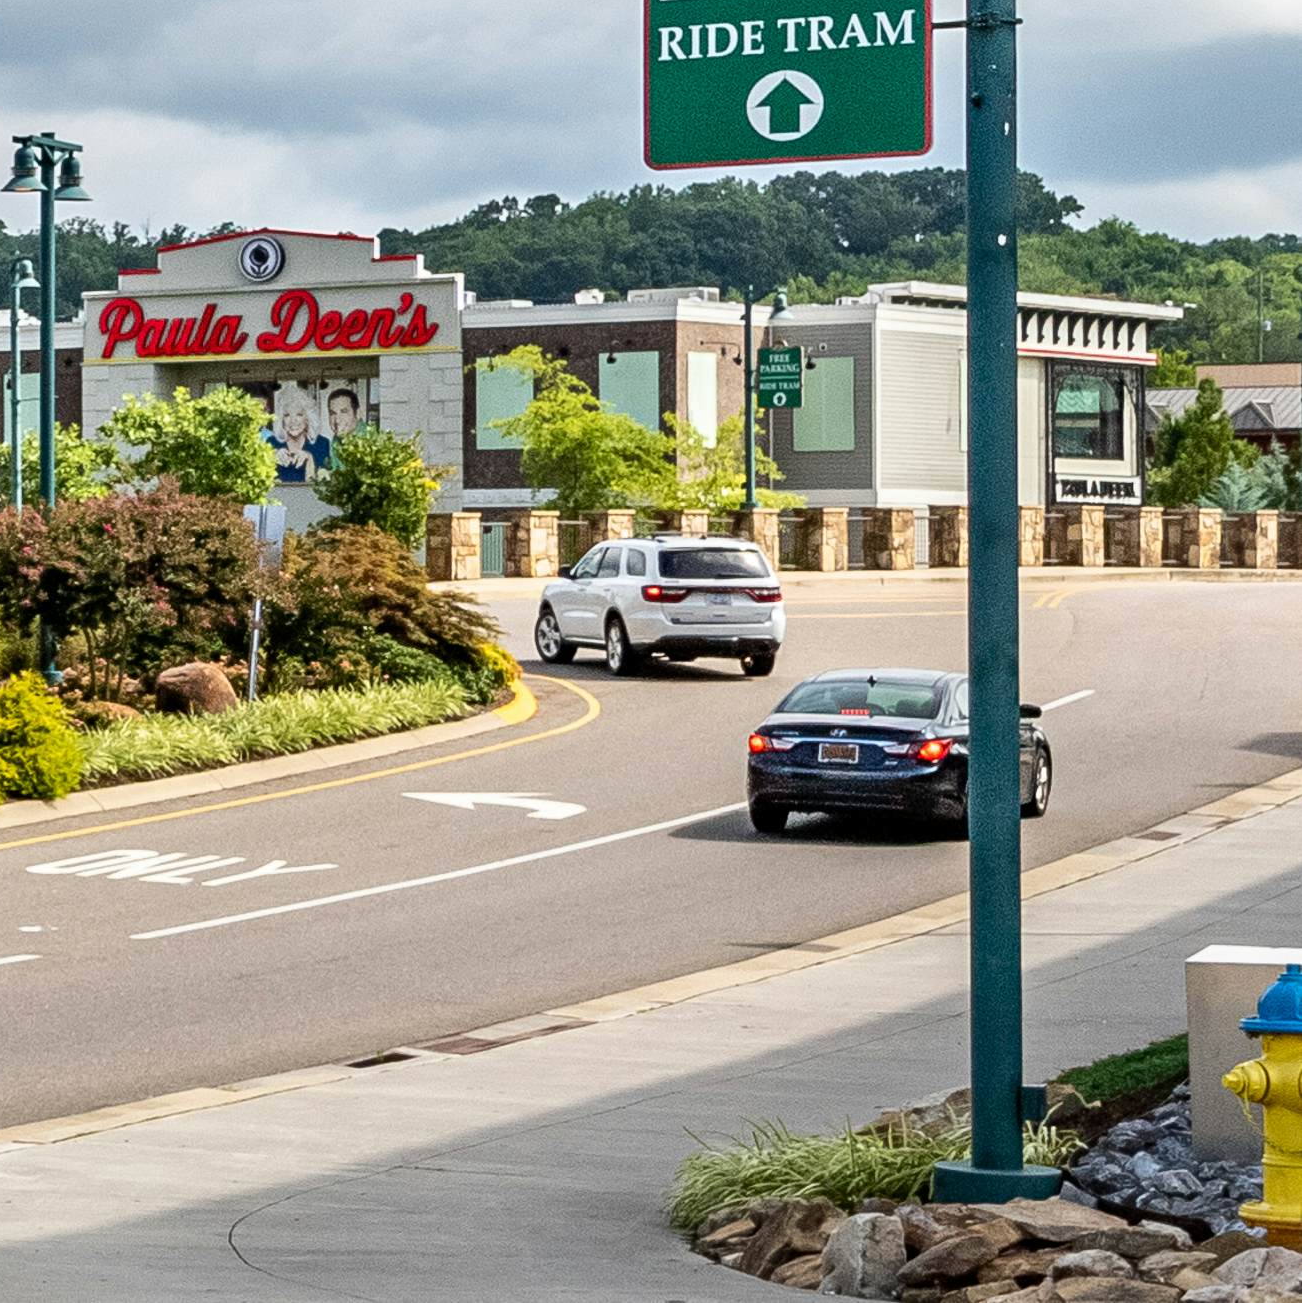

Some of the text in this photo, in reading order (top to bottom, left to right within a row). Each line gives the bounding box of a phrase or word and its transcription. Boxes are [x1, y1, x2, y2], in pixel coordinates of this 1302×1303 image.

[657, 9, 916, 62] RIDE TRAM
[99, 289, 439, 359] Paula Deen's
[760, 364, 800, 374] PARKING
[769, 353, 791, 363] FREE
[25, 849, 339, 887] ONLY
